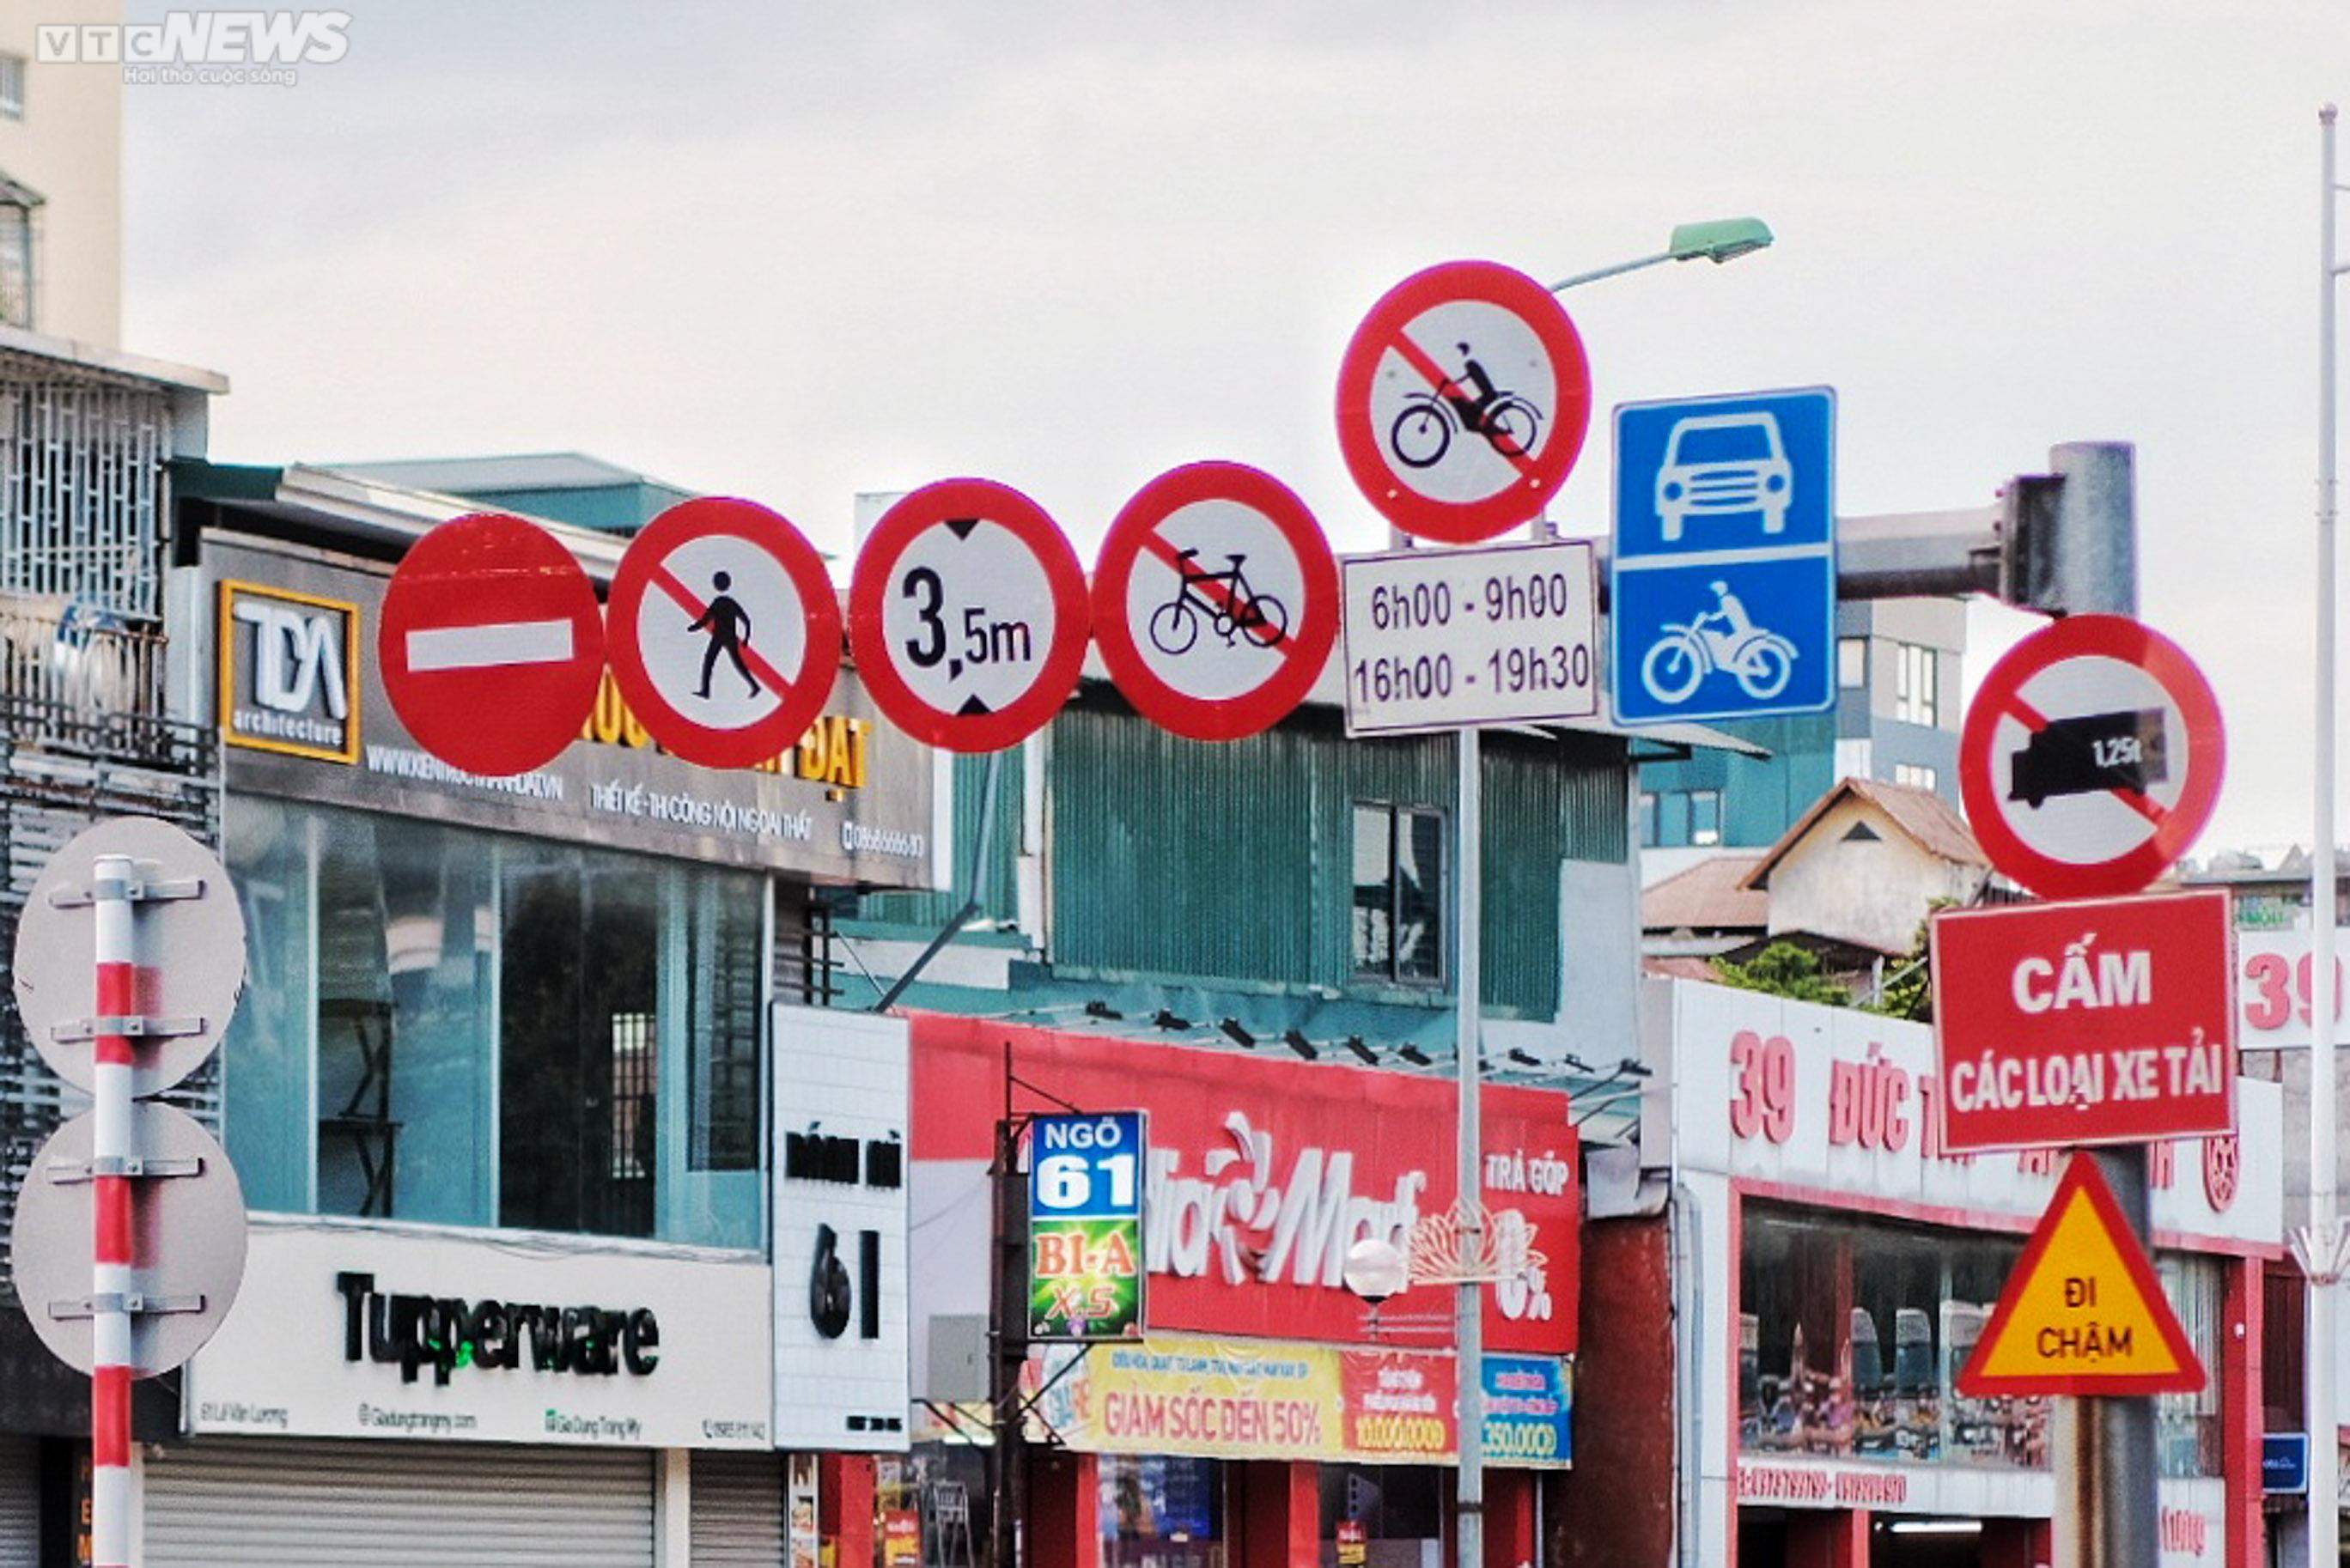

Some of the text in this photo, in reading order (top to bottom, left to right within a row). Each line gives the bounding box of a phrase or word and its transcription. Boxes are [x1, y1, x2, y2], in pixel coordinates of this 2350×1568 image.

[1373, 581, 1451, 629] 6h00
[1486, 574, 1567, 621] 9h00
[1355, 653, 1452, 702] 16h00
[1489, 644, 1589, 693] 19h30
[233, 709, 343, 747] architecture
[2012, 933, 2152, 1014] CẤM
[1730, 1030, 1795, 1145] 39
[1829, 1042, 1911, 1152] ĐỨC
[1951, 1026, 2222, 1114] CÁC LOẠI XE TẢI
[1045, 1116, 1122, 1149] NGÕ
[1036, 1153, 1135, 1209] 61
[1484, 1148, 1526, 1192] TRẢ
[2065, 1277, 2097, 1307] ĐI
[337, 1271, 660, 1387] Tupperware
[2036, 1322, 2134, 1364] CHẬM
[1104, 1380, 1165, 1439] GIẢM
[1169, 1385, 1217, 1442] SỐC
[1272, 1400, 1322, 1445] 50%
